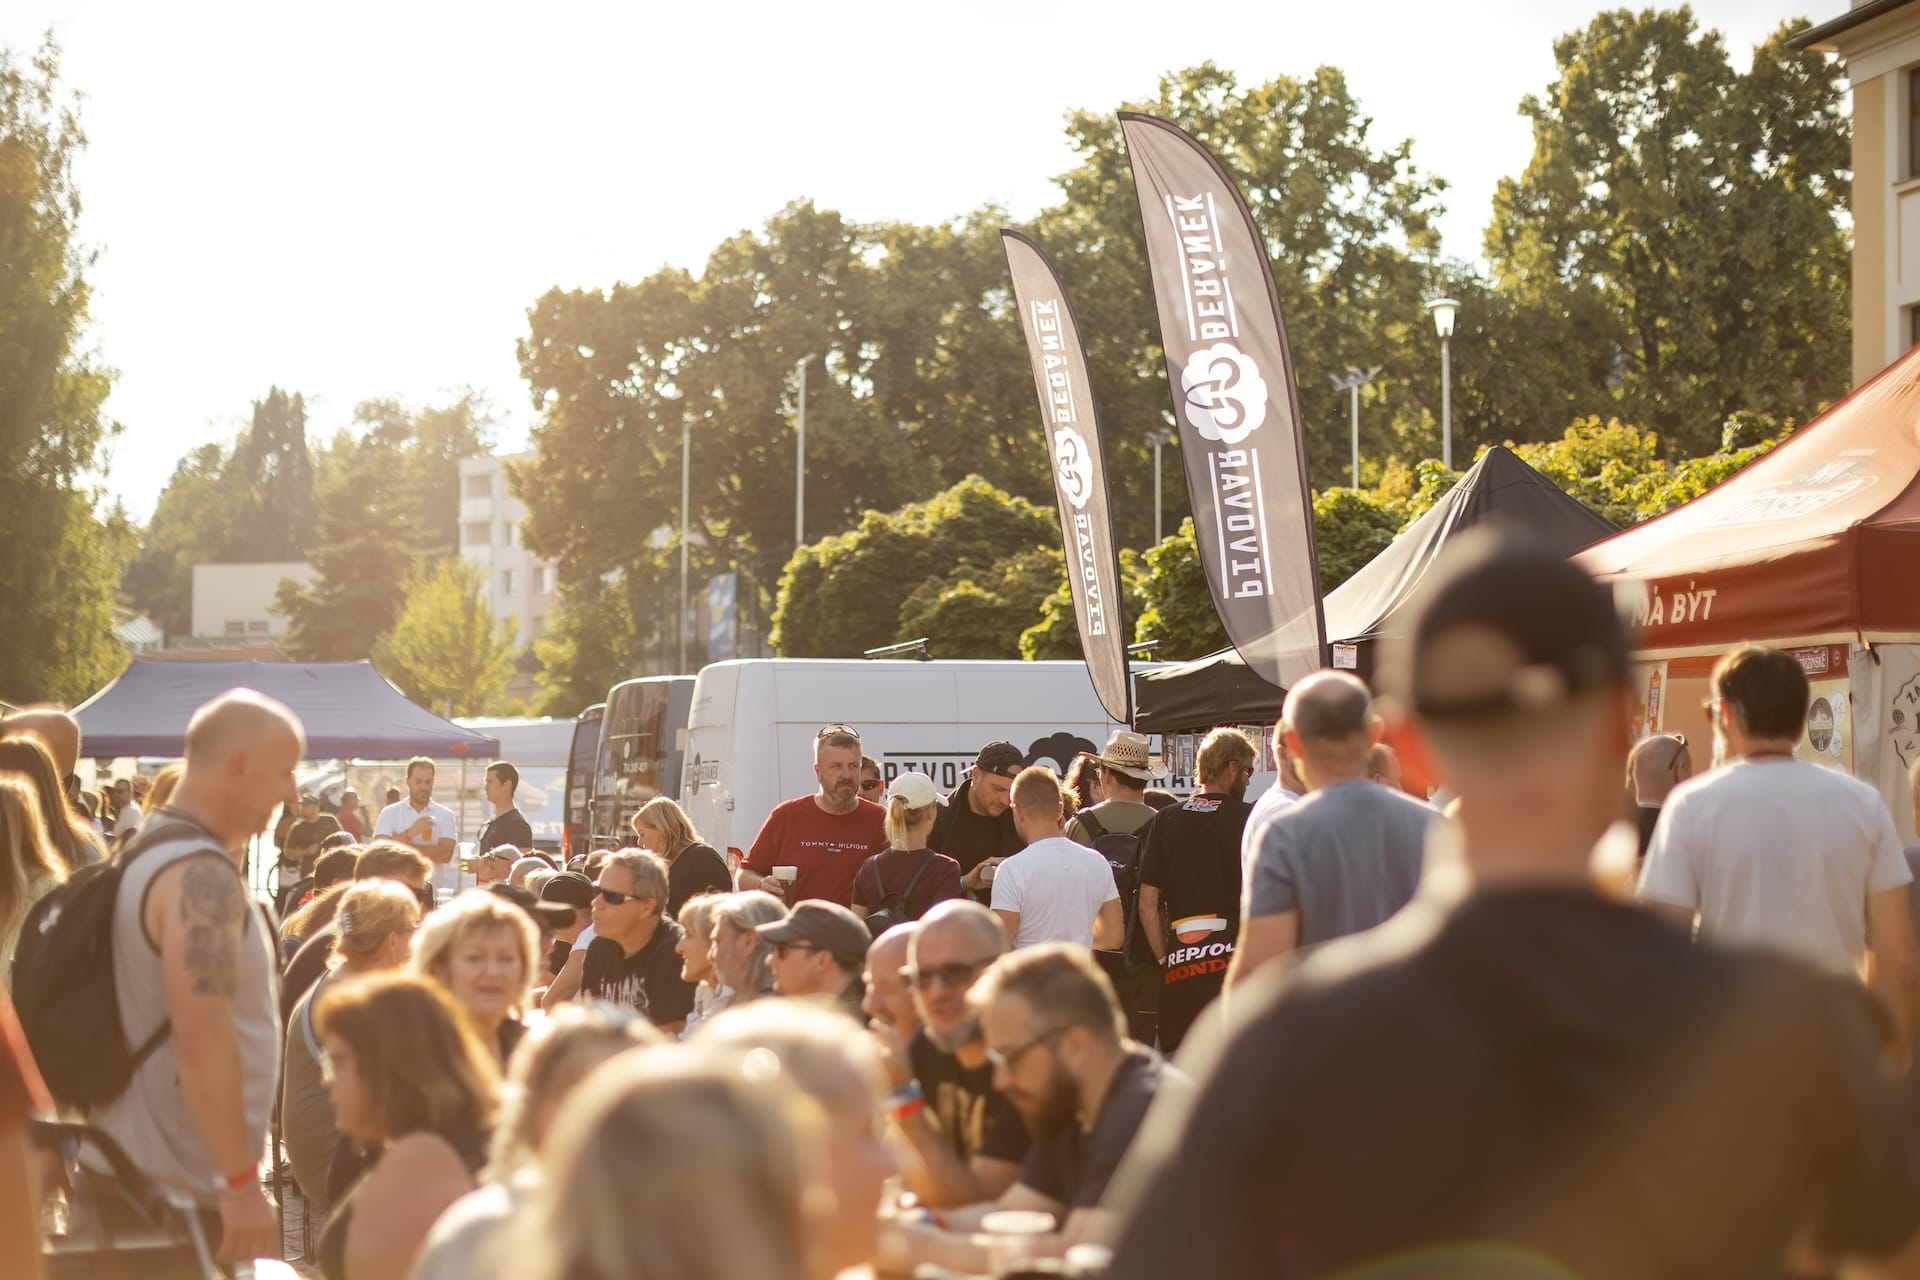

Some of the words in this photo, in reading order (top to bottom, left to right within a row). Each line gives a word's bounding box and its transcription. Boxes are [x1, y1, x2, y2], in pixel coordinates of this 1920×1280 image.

[1670, 580, 1717, 625] BÝT
[1164, 954, 1233, 985] HOND
[1167, 942, 1235, 968] REPSOL
